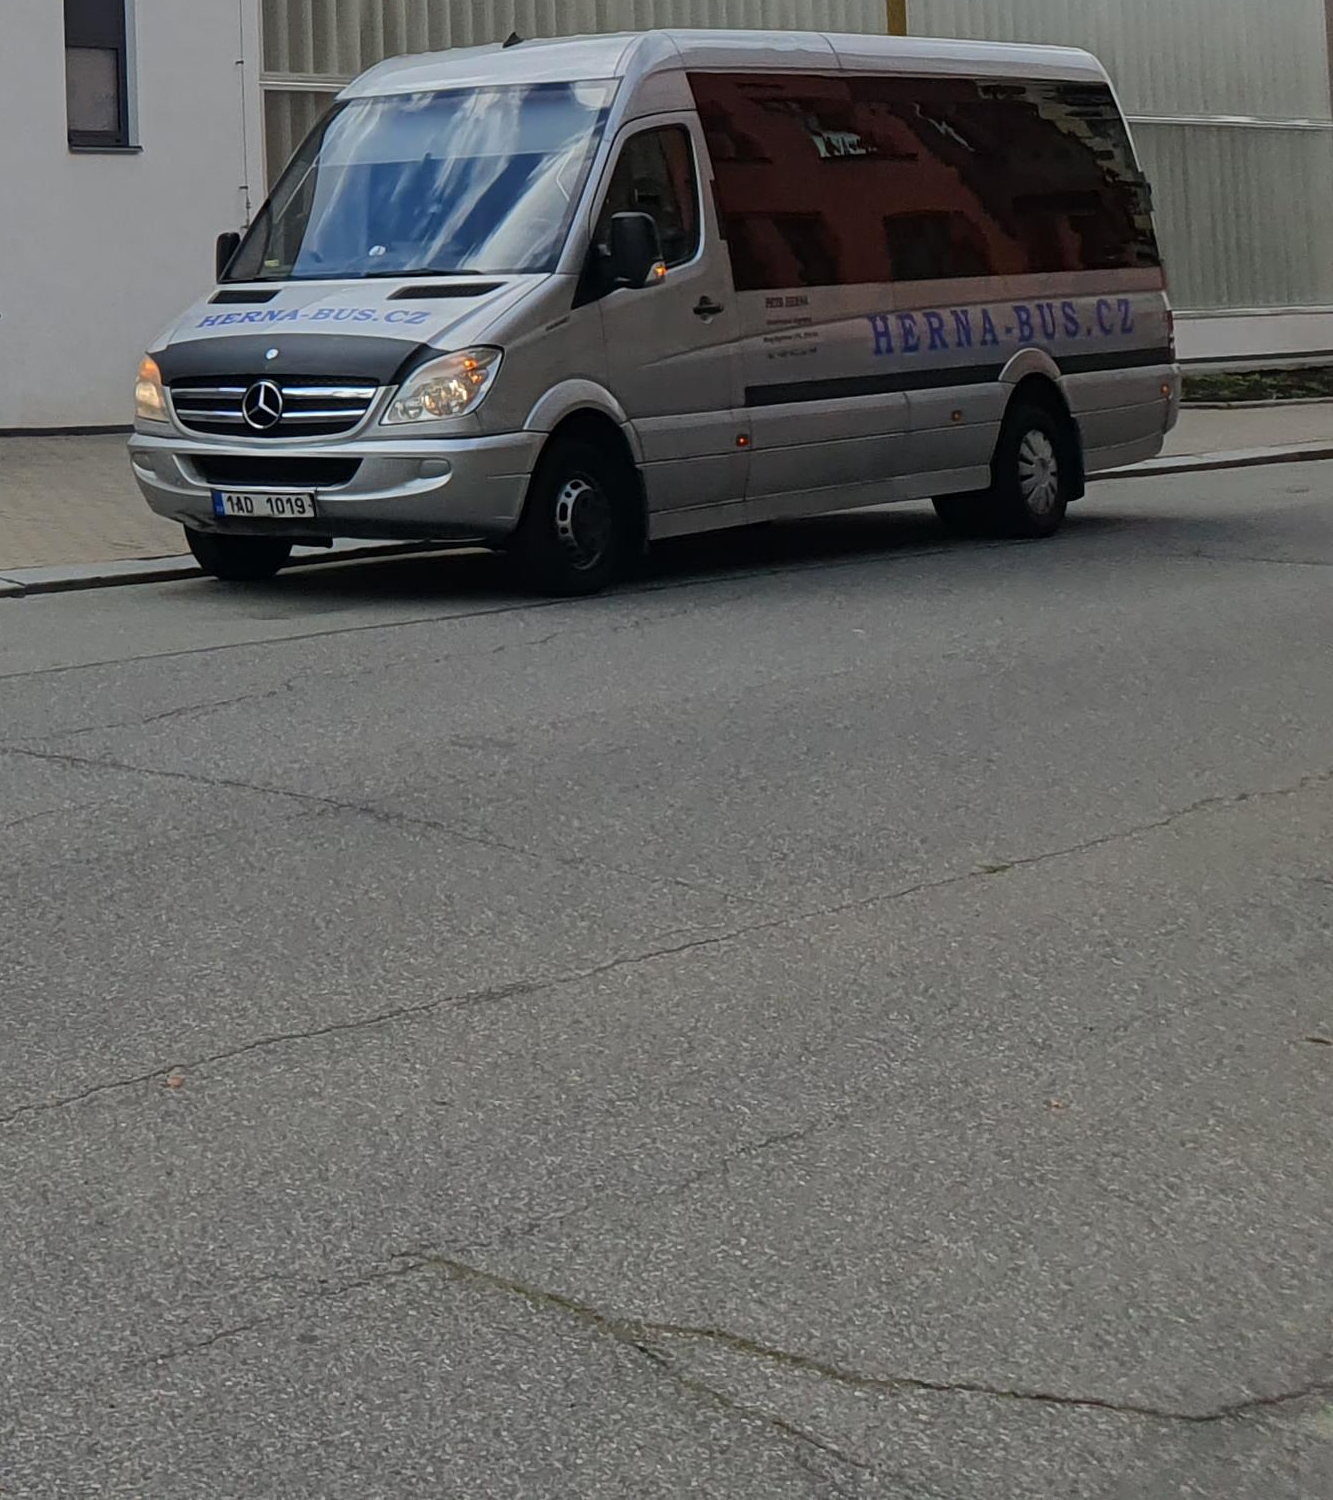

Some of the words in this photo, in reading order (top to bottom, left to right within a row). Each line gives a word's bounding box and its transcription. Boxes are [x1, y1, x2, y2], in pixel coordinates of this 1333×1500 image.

[196, 308, 431, 328] HERNA-BUS.CZ
[868, 298, 1133, 356] HERNA-BUS.CZ
[226, 496, 253, 514] 1AD
[266, 497, 306, 515] 1019
